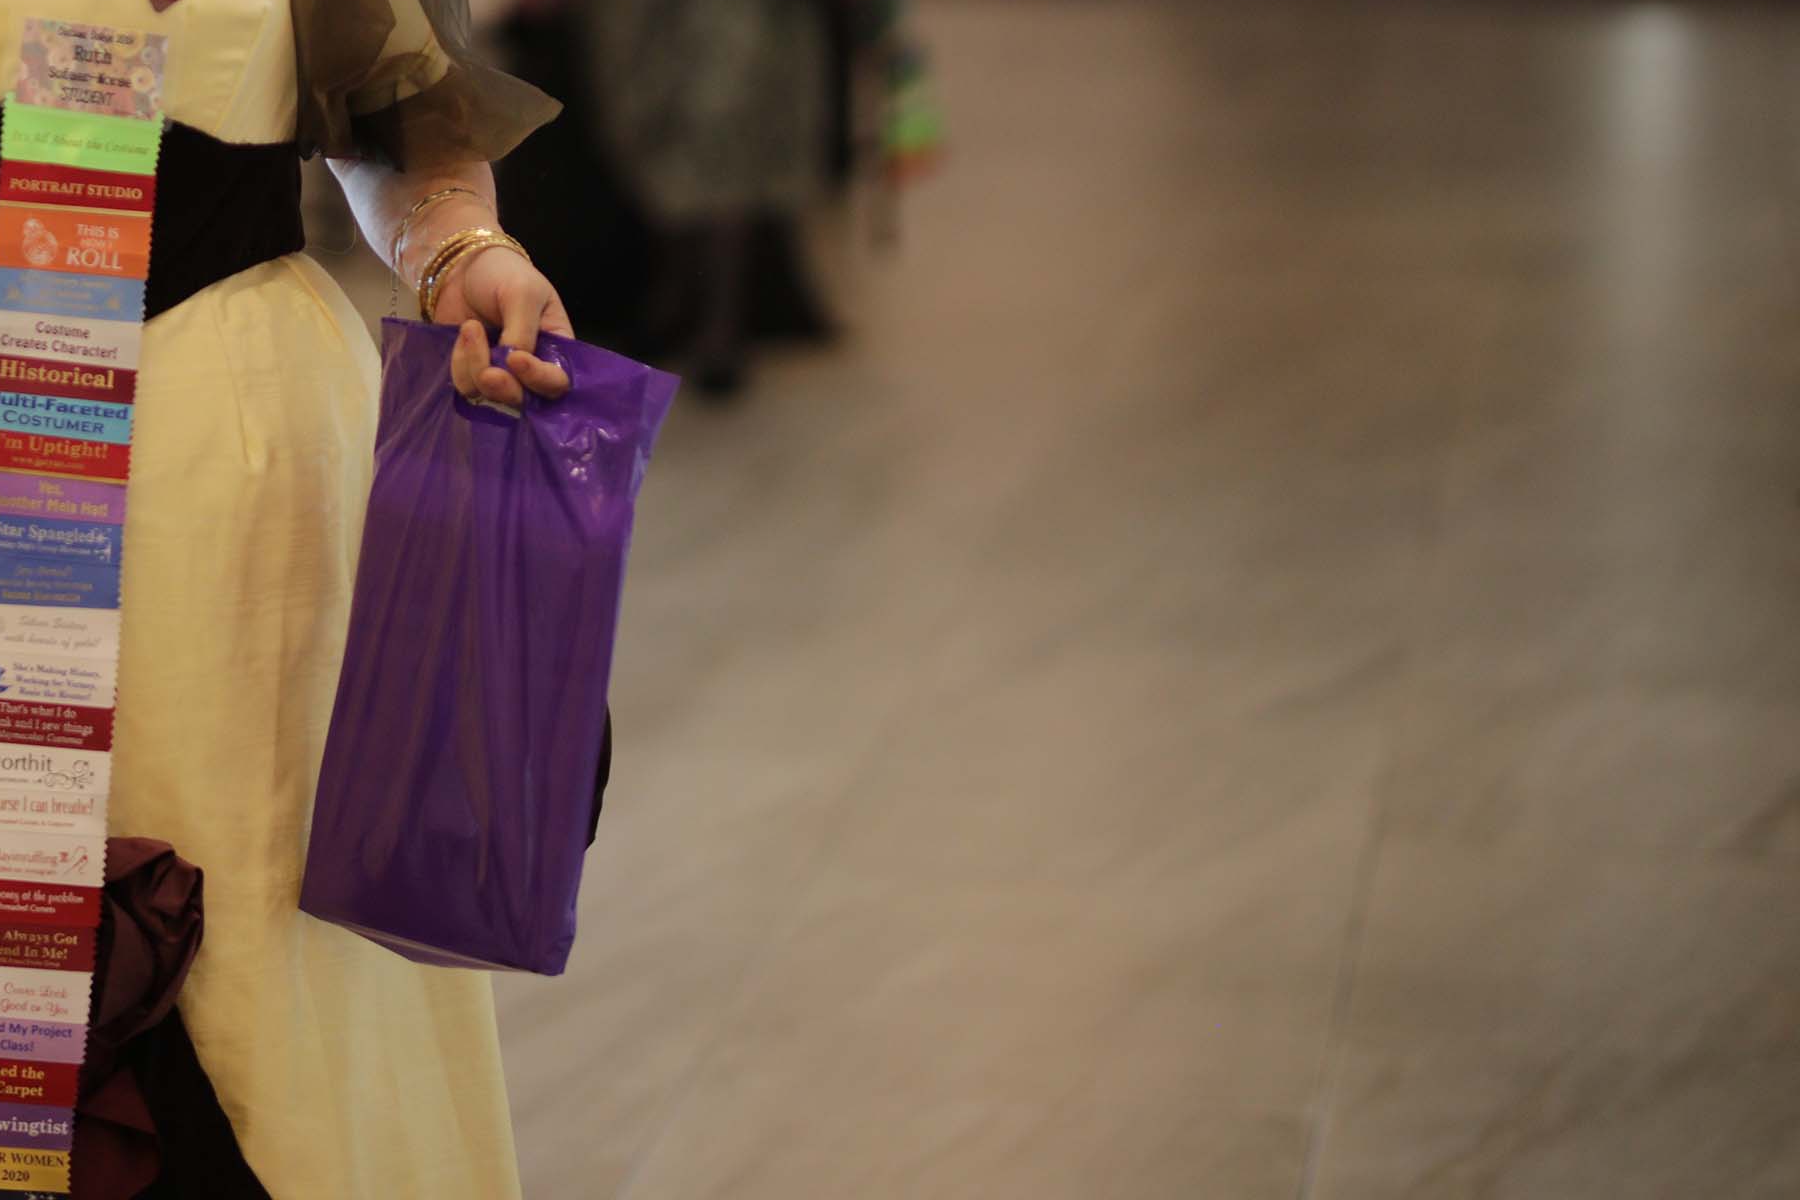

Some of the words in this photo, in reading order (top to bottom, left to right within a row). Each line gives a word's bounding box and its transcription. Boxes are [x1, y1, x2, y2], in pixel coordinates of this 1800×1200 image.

[61, 87, 115, 105] STUDENT
[9, 178, 85, 195] PORTRAIT
[87, 184, 143, 200] STUDIO
[76, 223, 105, 238] THIS
[107, 227, 120, 239] IS
[66, 247, 123, 270] ROLL
[35, 320, 90, 339] Costume
[0, 333, 48, 351] Creates
[51, 339, 119, 360] Character!
[0, 359, 115, 390] Historical
[29, 435, 109, 459] Uptight!
[29, 525, 95, 544] Spangled
[12, 663, 34, 672] She's
[36, 665, 67, 676] Making
[43, 688, 57, 698] the
[31, 704, 54, 715] what
[56, 707, 61, 717] I
[64, 707, 77, 718] do
[15, 718, 33, 730] and
[35, 719, 40, 730] I
[42, 721, 60, 731] sew
[63, 721, 93, 737] things
[23, 796, 27, 812] I
[30, 800, 48, 813] can
[51, 797, 95, 815] breathe!
[21, 891, 31, 901] at
[33, 889, 46, 902] the
[48, 892, 84, 905] problem
[3, 930, 50, 945] Always
[53, 932, 78, 945] Got
[24, 947, 38, 956] In
[41, 946, 68, 960] Me!
[45, 1001, 69, 1016] You
[9, 1023, 27, 1036] My
[31, 1025, 72, 1040] Project
[0, 1039, 35, 1052] Class!
[21, 1066, 45, 1080] the
[11, 1153, 65, 1167] WOMEN
[1, 1169, 30, 1182] 2020
